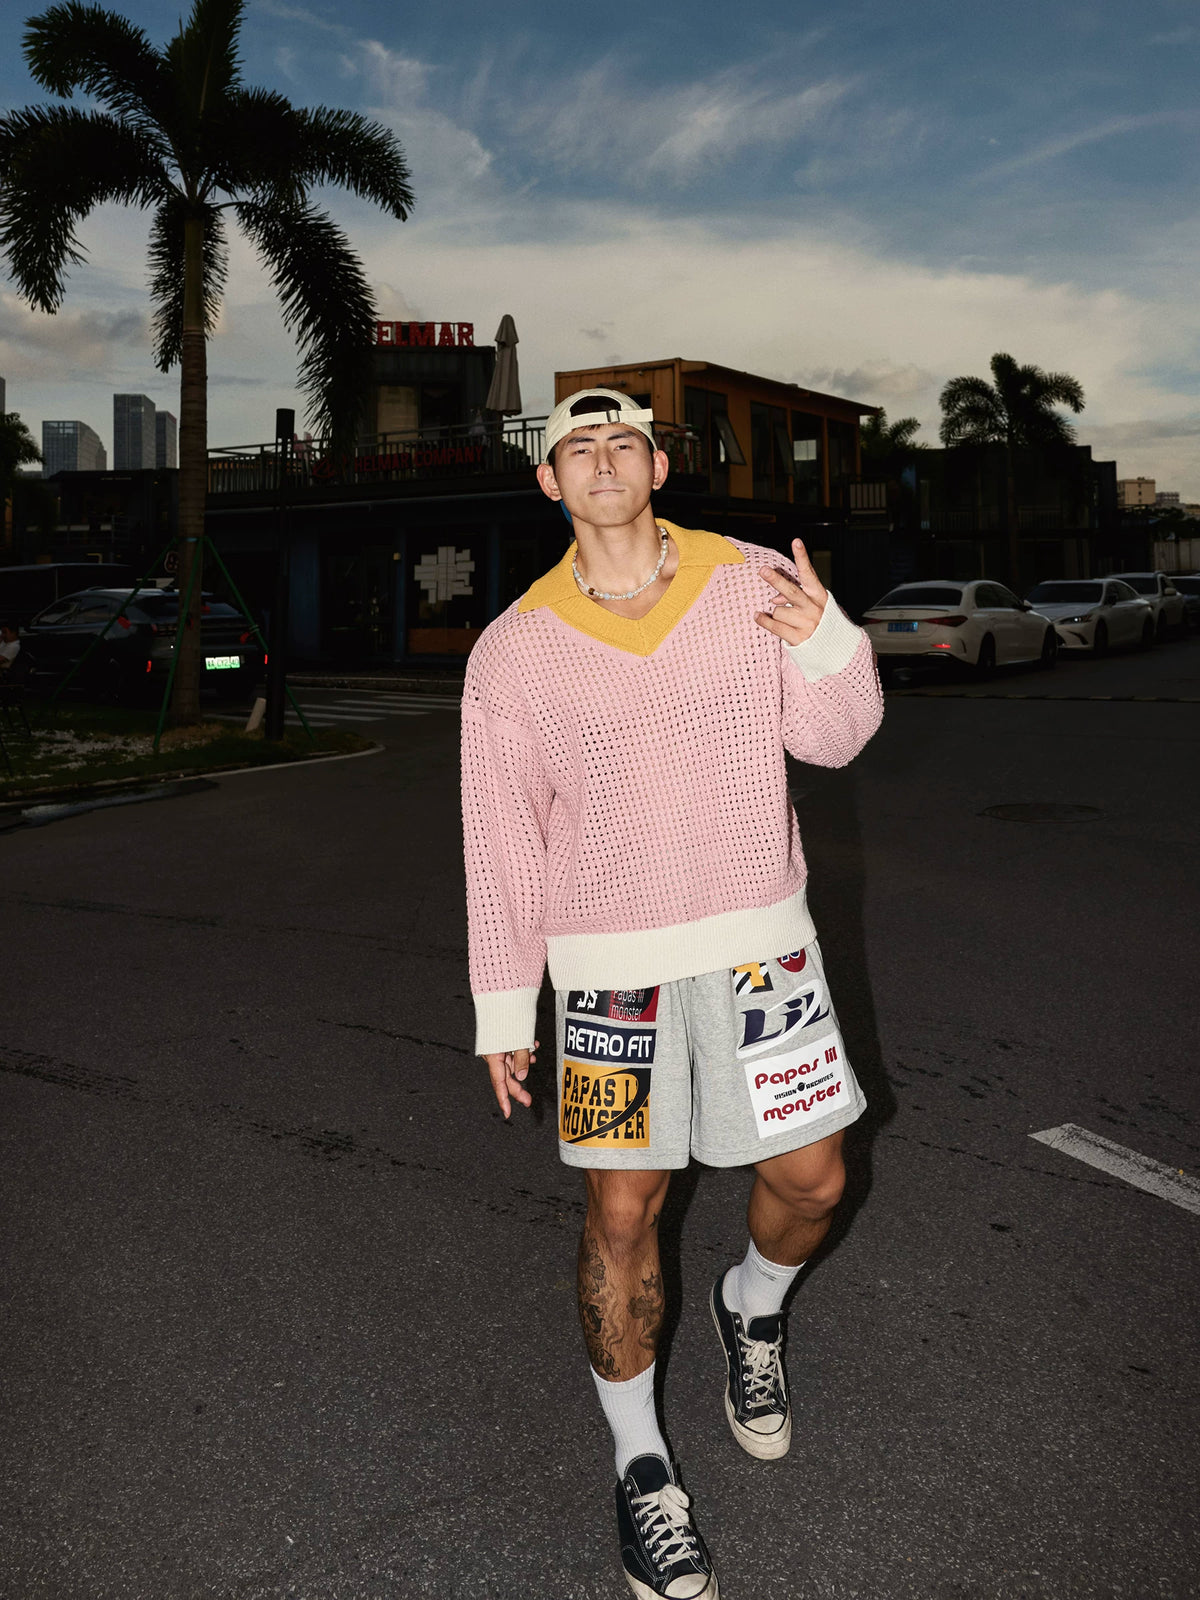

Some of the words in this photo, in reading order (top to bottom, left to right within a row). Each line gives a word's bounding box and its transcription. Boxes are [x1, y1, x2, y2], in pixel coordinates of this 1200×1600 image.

[367, 321, 474, 347] ELMAR
[414, 445, 485, 468] COMPANY
[610, 1004, 643, 1021] monster
[566, 1025, 625, 1057] RETRO
[627, 1035, 653, 1058] FIT
[563, 1066, 617, 1107] PAPAS
[754, 1057, 820, 1090] Papas
[774, 1087, 798, 1101] VISION
[805, 1071, 834, 1090] ARCHIVES
[762, 1081, 842, 1122] monster
[562, 1105, 646, 1140] MONSTER
